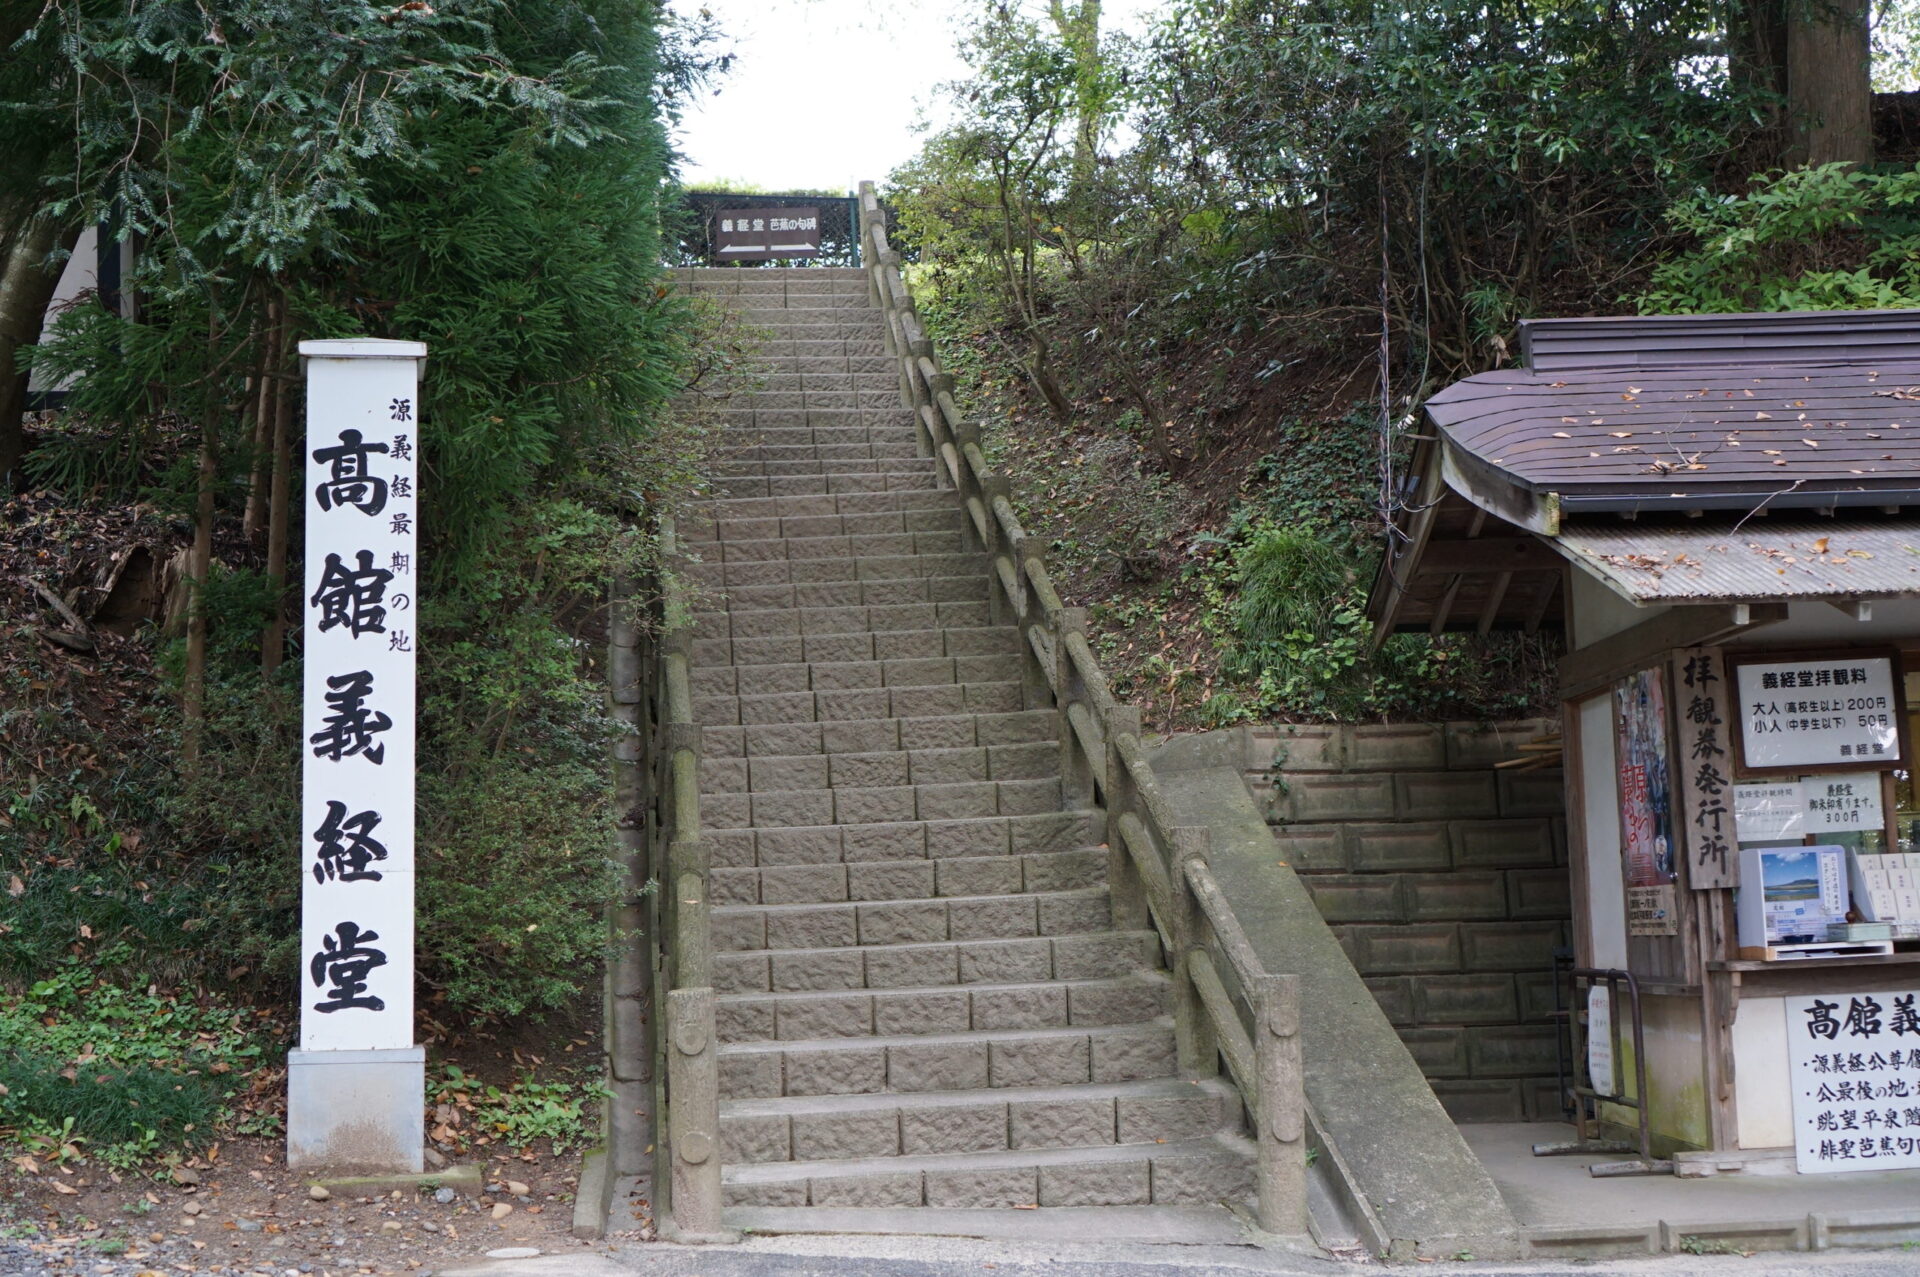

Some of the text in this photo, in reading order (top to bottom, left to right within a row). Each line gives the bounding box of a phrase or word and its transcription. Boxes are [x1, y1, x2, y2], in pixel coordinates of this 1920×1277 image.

[388, 397, 413, 653] 源義経最期の地
[1762, 668, 1867, 689] 義経堂拝観料
[1753, 702, 1780, 716] 大人
[1754, 719, 1782, 734] 小人
[1840, 743, 1885, 757] 義経堂
[1818, 1135, 1920, 1163] 俳聖芭蕉句
